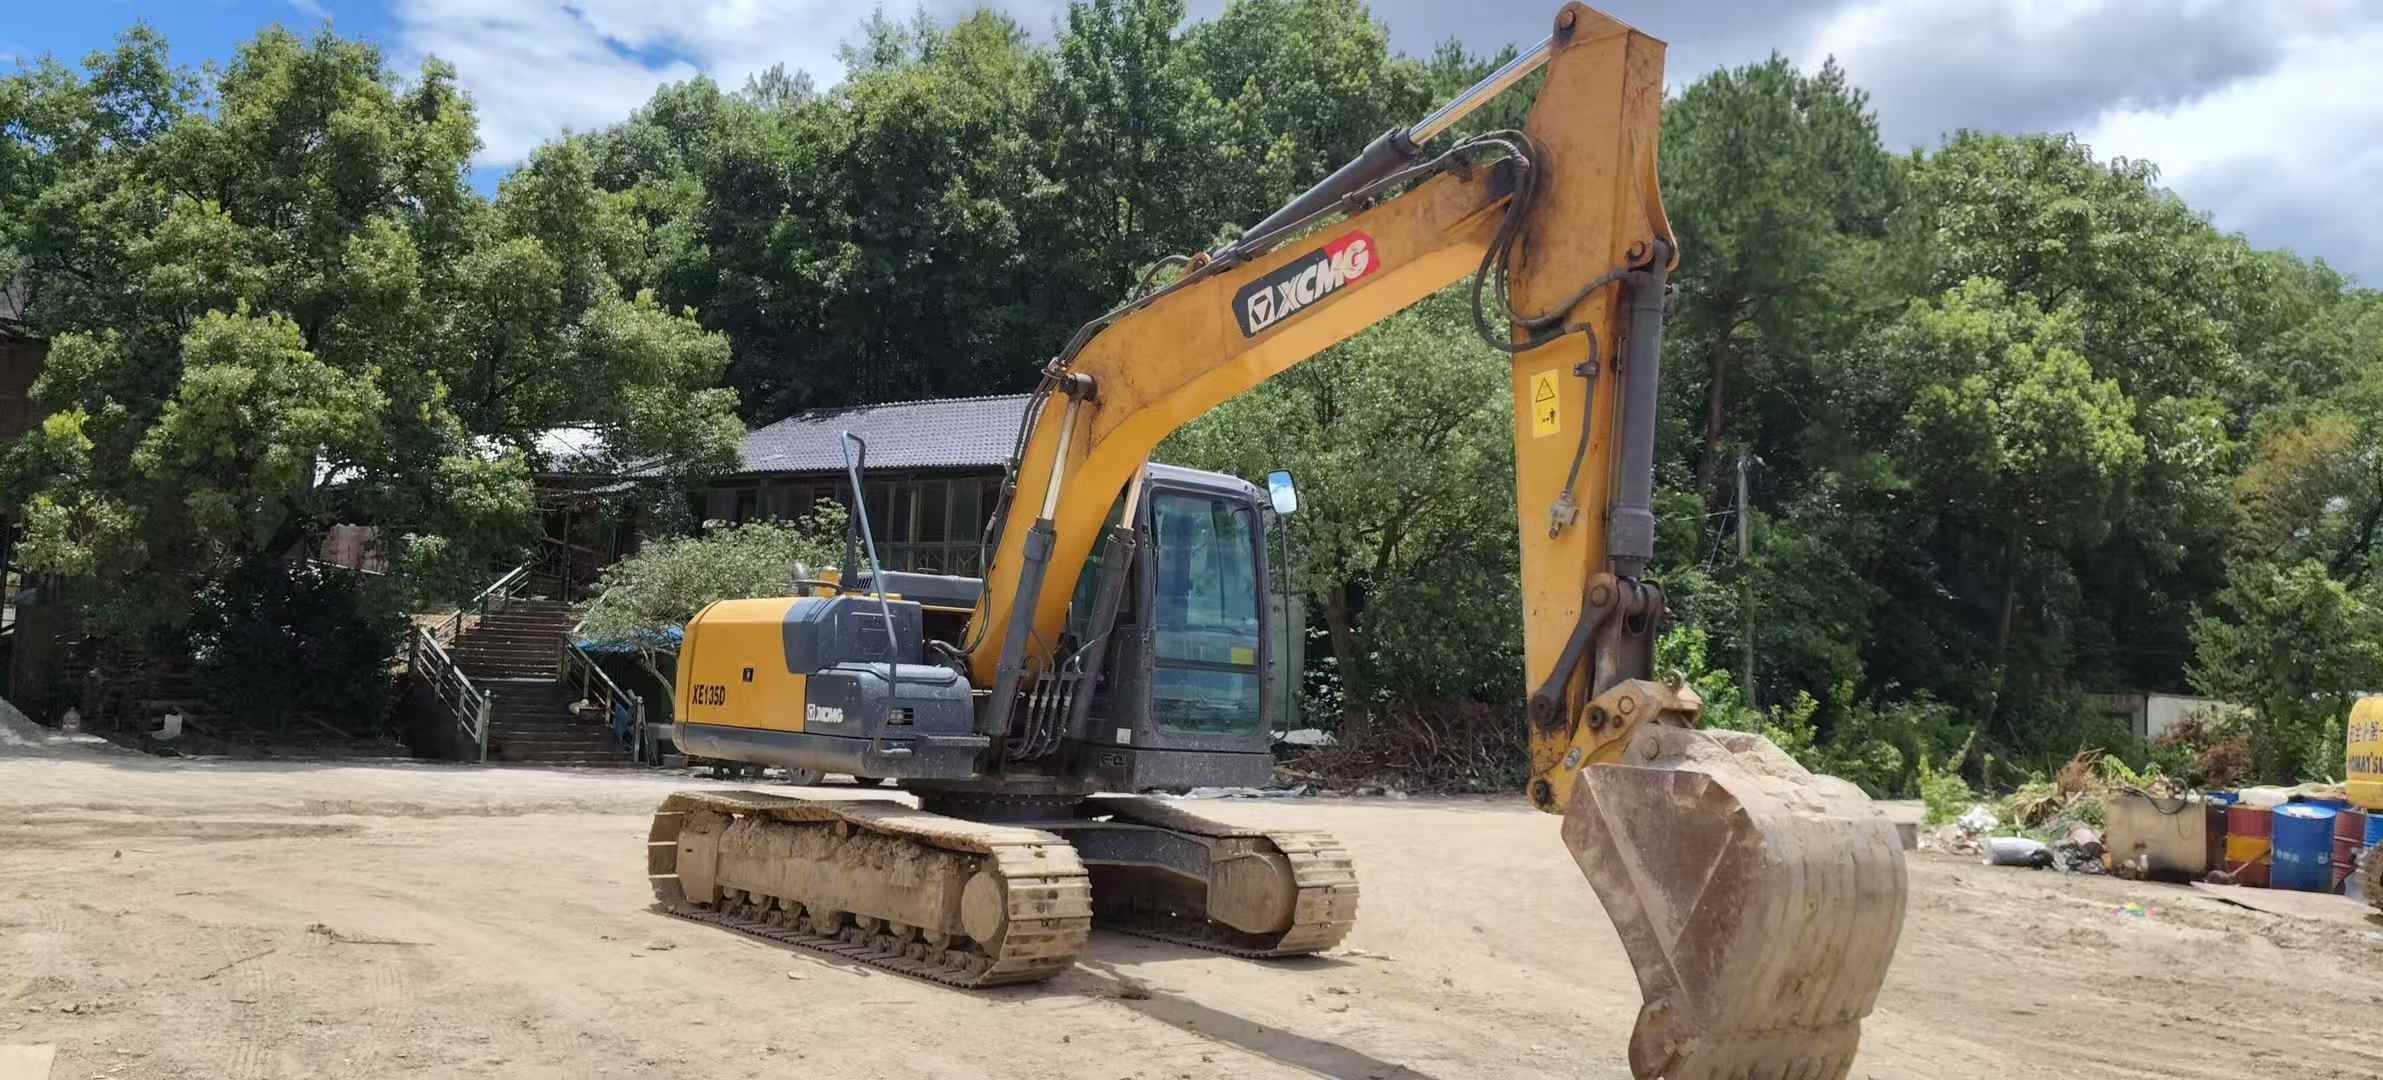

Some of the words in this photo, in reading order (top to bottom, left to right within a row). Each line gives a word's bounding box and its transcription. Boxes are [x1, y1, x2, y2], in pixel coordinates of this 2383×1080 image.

[1276, 239, 1369, 319] XCMG
[692, 684, 726, 706] XE135D
[815, 706, 844, 723] XCMG
